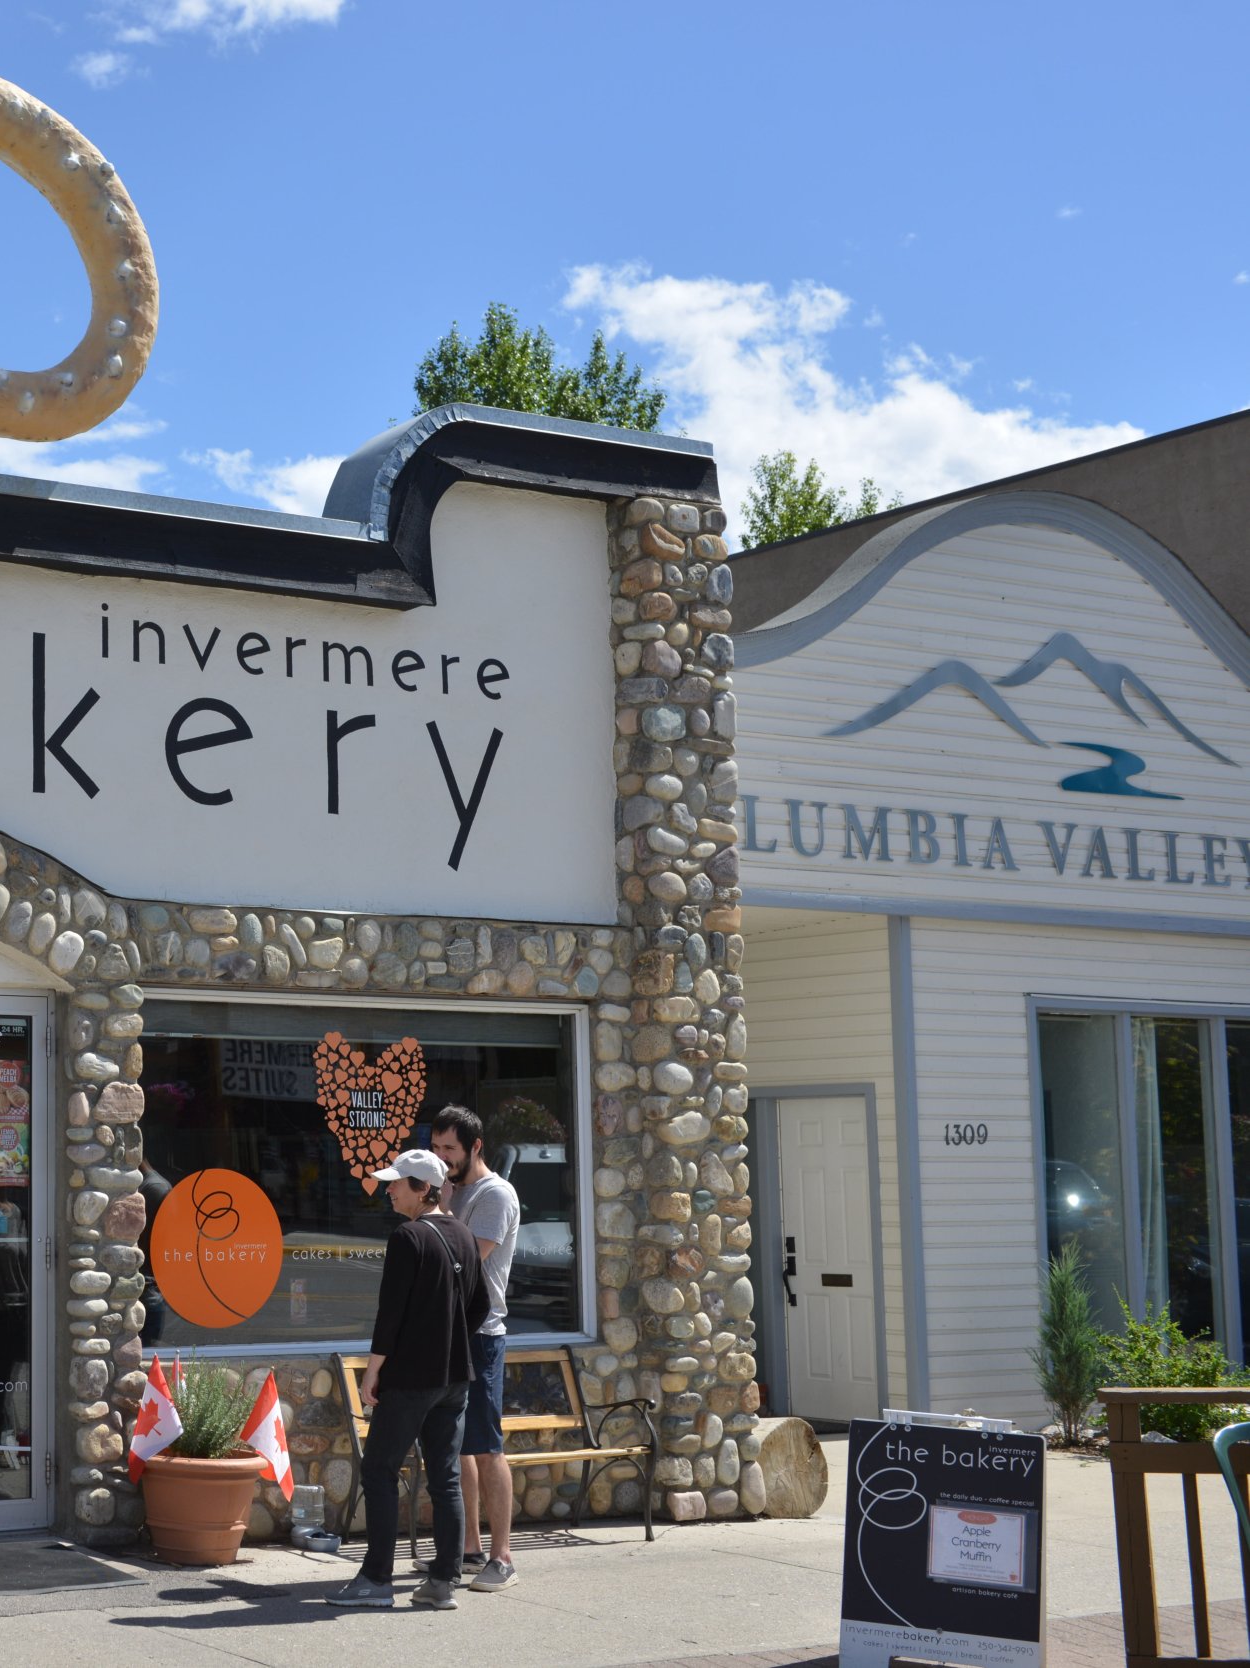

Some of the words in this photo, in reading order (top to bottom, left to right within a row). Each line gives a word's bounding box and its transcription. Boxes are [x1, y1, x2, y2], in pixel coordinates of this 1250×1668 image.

[101, 603, 510, 700] invermere
[351, 1091, 382, 1108] VALLEY
[349, 1110, 385, 1128] STRONG
[944, 1123, 988, 1146] 1309
[164, 1248, 193, 1262] the
[205, 1247, 266, 1263] bakery
[292, 1247, 332, 1260] cakes
[886, 1440, 929, 1463] the
[942, 1444, 1035, 1478] bakery
[989, 1446, 1037, 1457] invermere
[962, 1526, 991, 1537] Apple
[951, 1536, 1002, 1552] Cranberry
[960, 1551, 992, 1562] Muffin
[978, 1589, 1002, 1598] bakery
[845, 1624, 969, 1647] invermerebakery.com
[863, 1640, 884, 1648] cakes
[892, 1644, 916, 1652] sweets
[924, 1648, 953, 1657] savoury
[960, 1651, 982, 1660] bread
[990, 1655, 1014, 1664] coffee
